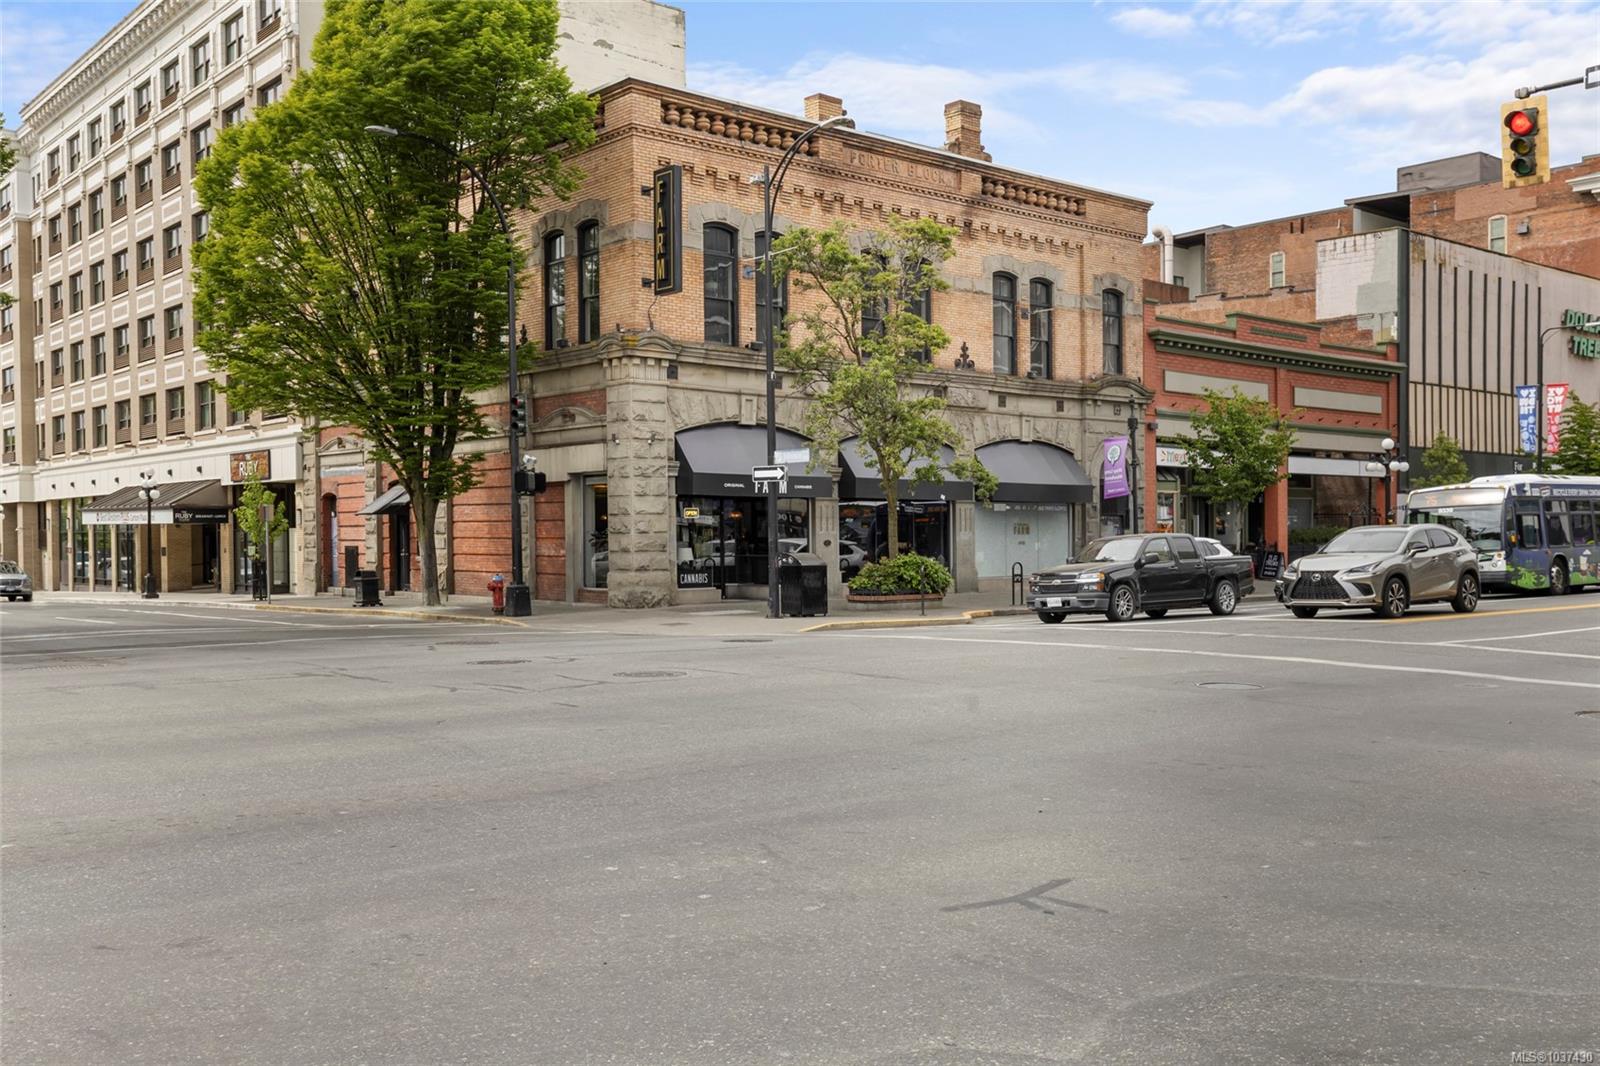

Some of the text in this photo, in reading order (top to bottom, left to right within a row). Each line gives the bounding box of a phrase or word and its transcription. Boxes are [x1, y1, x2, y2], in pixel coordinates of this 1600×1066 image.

[656, 180, 665, 280] FARM
[754, 481, 788, 494] FAM
[680, 573, 708, 584] CANNABIS
